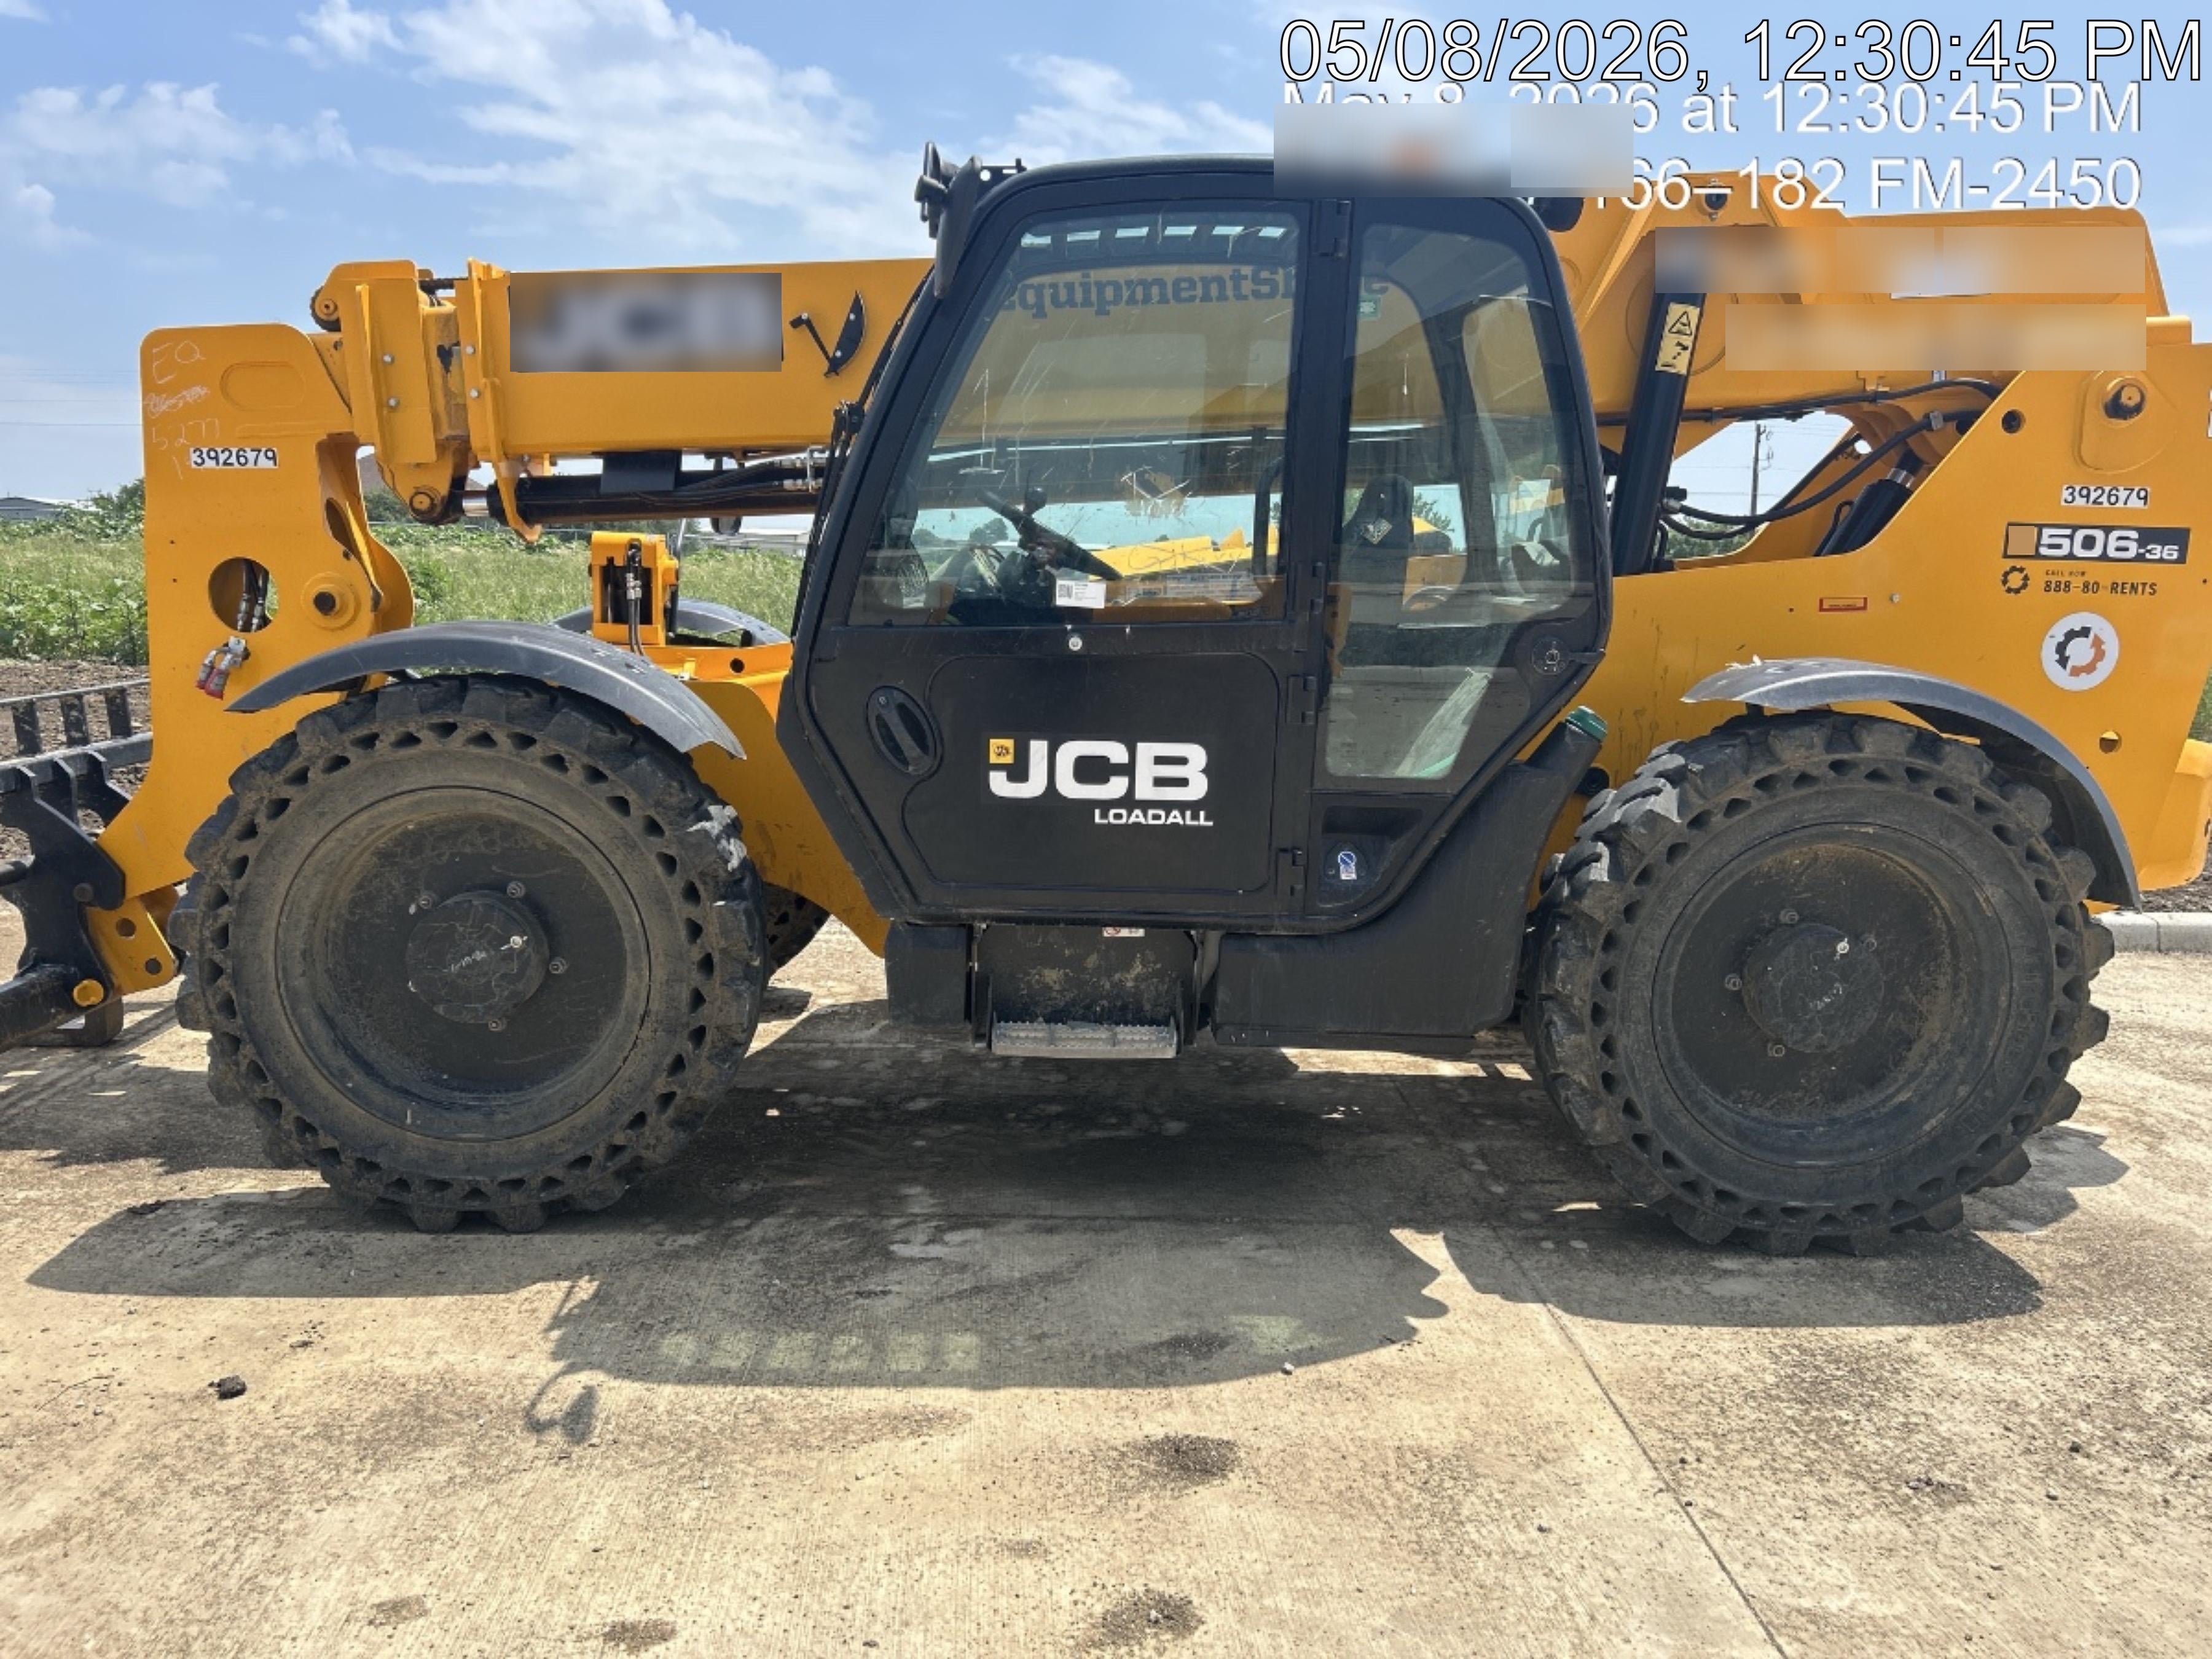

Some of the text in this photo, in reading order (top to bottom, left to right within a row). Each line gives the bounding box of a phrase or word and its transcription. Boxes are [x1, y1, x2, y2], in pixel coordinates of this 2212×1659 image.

[192, 448, 277, 467] 392679
[2063, 485, 2149, 506] 392679
[2038, 527, 2179, 560] 506-36
[989, 739, 1208, 801] JCB
[1094, 809, 1214, 826] LOADALL
